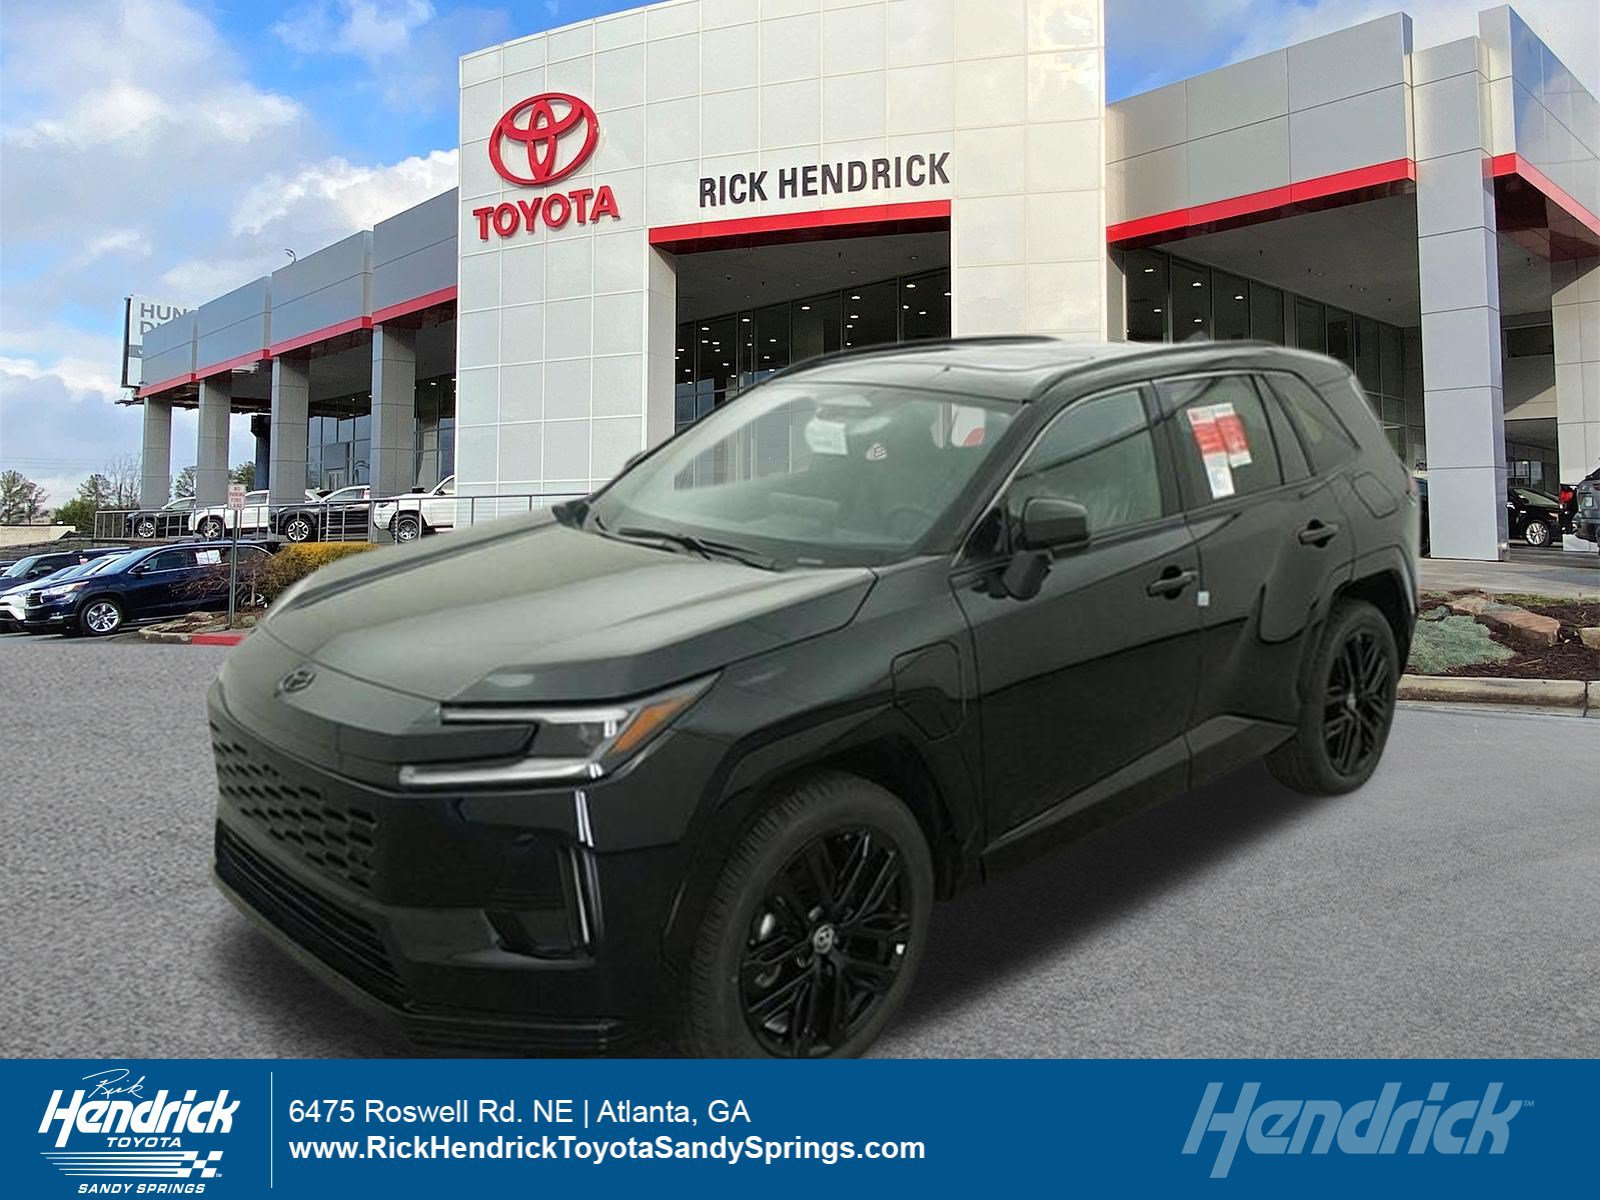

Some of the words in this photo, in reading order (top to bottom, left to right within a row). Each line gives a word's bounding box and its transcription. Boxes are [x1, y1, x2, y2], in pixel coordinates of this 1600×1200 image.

[699, 170, 768, 208] RICK
[778, 152, 952, 200] HENDRICK
[472, 185, 621, 241] TOYOTA
